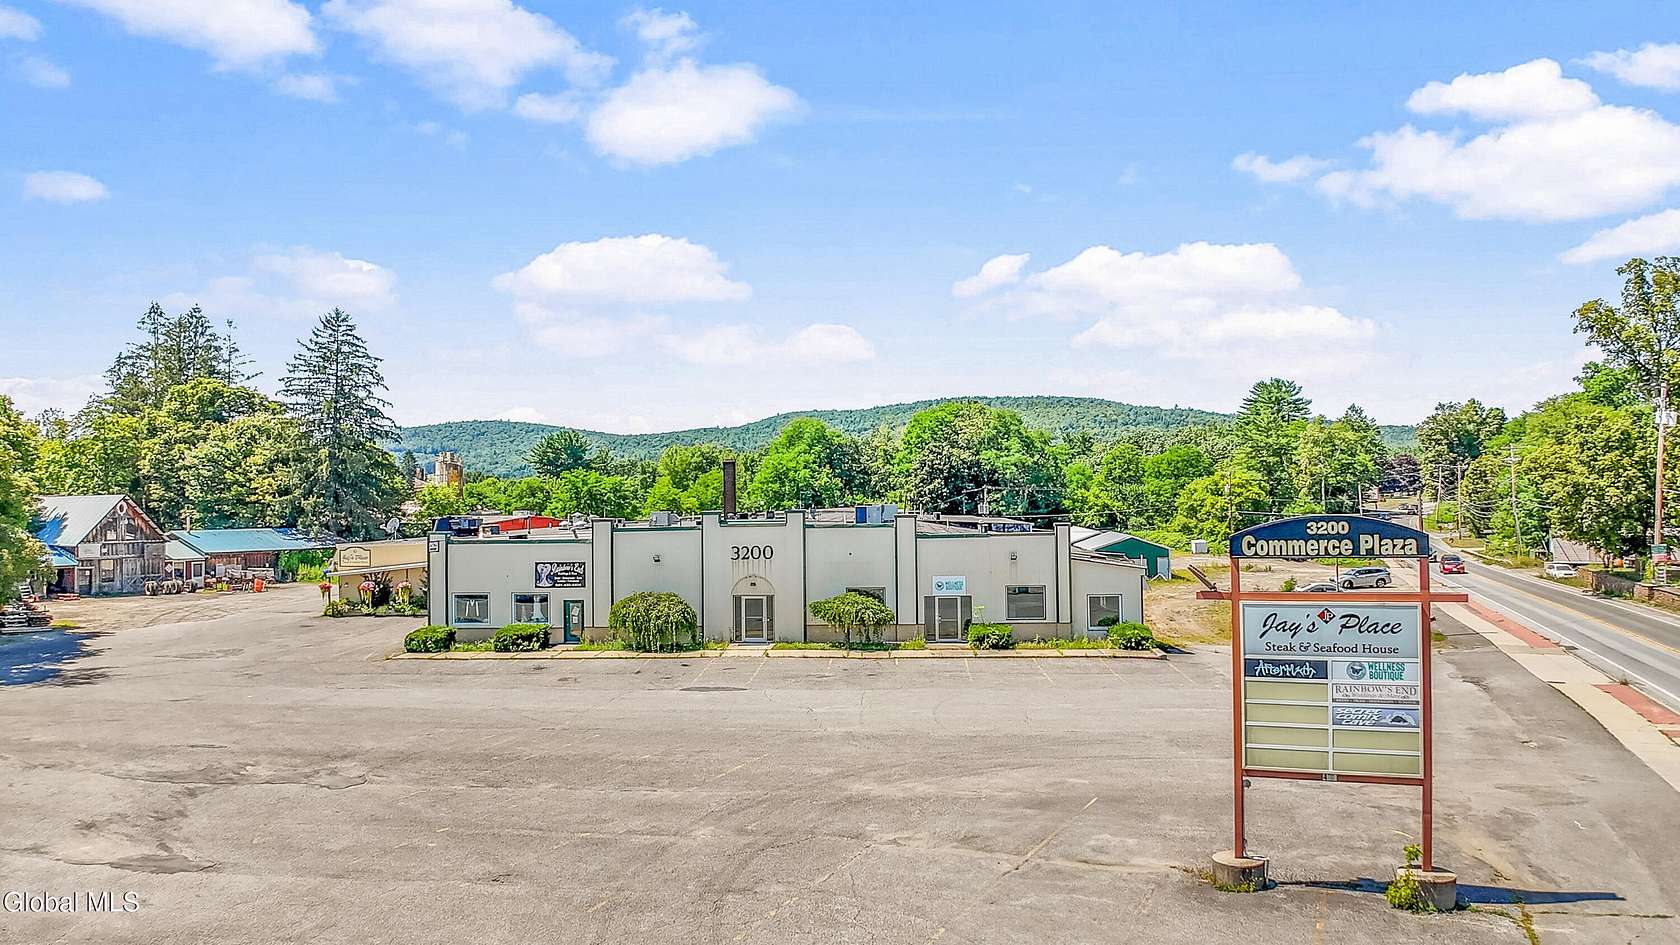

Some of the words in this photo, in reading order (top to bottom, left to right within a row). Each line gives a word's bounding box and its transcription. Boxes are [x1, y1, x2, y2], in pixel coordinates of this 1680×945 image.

[1306, 521, 1350, 535] 3200
[1241, 535, 1353, 556] Commerce
[1359, 534, 1418, 556] Plaza
[730, 545, 774, 560] 3200
[1259, 612, 1320, 639] Jay's
[1338, 613, 1403, 635] Place
[1265, 641, 1296, 652] Steak
[1298, 642, 1313, 652] &
[1314, 642, 1359, 654] Seafood
[1362, 643, 1400, 654] House
[1367, 662, 1406, 672] WELLNESS
[1369, 671, 1405, 681] BOUTIQUE
[1335, 685, 1393, 694] RAINBOW'S
[1395, 686, 1417, 696] END
